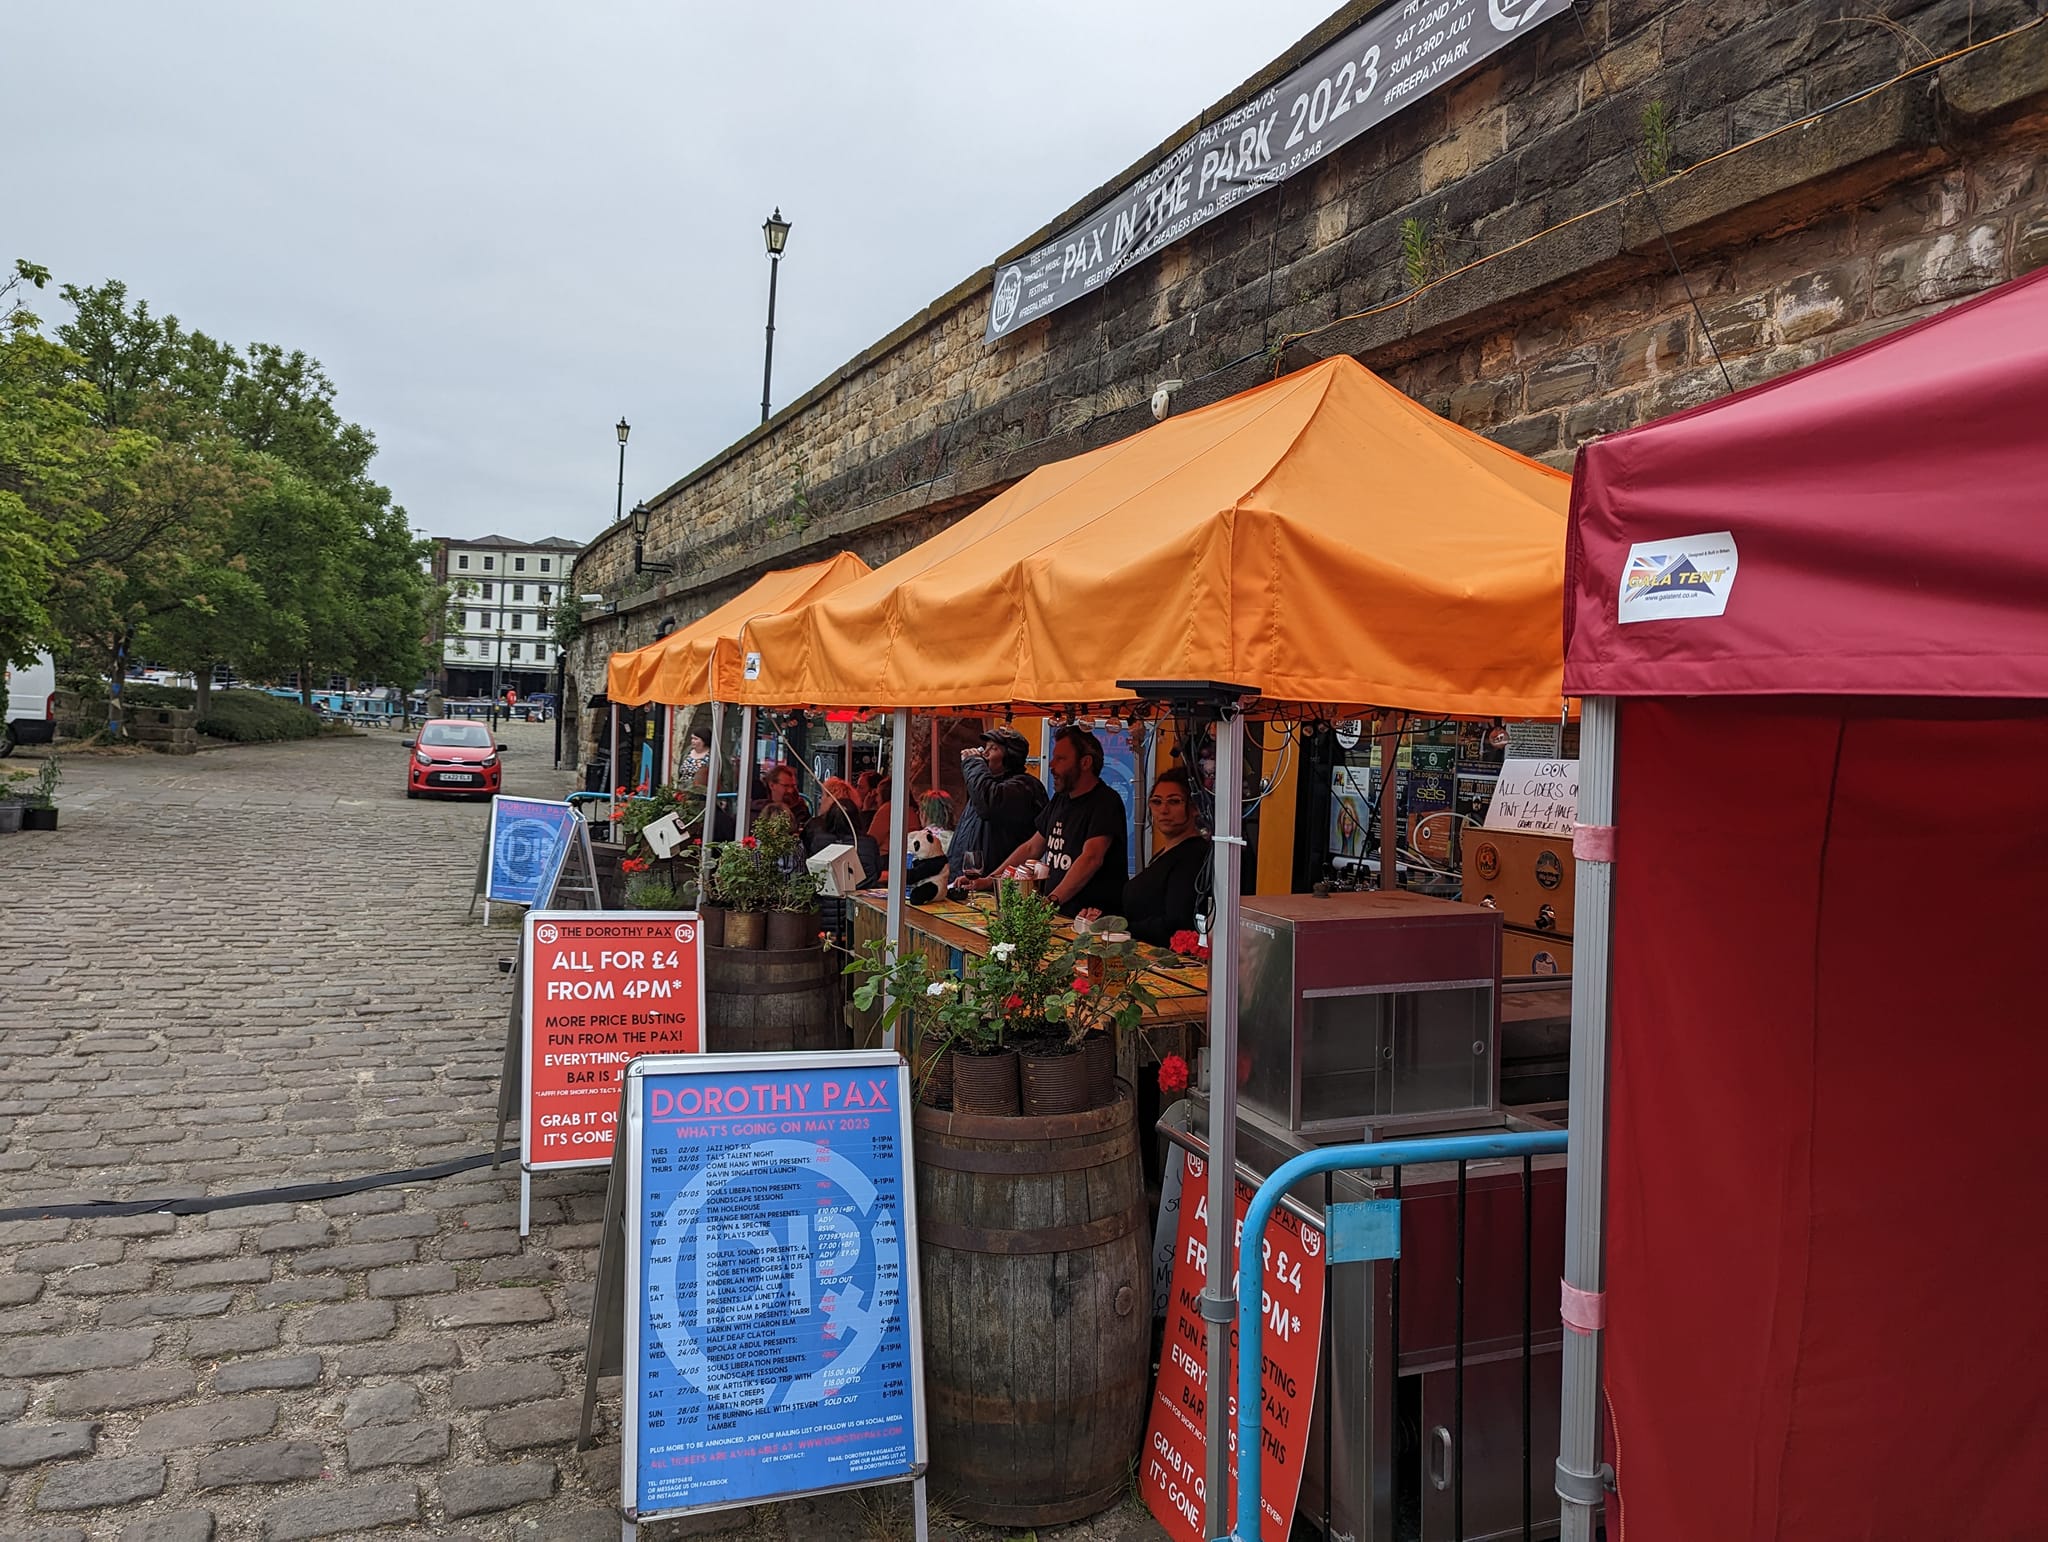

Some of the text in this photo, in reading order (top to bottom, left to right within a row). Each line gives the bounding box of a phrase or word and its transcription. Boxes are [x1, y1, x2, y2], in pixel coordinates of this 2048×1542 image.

[1394, 1, 1449, 50] SAT 22ND
[1390, 8, 1475, 77] SUN 23RD JULY
[1384, 37, 1471, 105] #FREEPAXPARK
[1133, 176, 1151, 197] THE
[1198, 123, 1220, 150] PAX
[1221, 88, 1279, 136] PRESENTS:
[1061, 44, 1381, 285] PAX IN THE PARK 2023
[1153, 215, 1191, 248] GLEADLESS
[1289, 152, 1301, 170] S2
[1628, 569, 1725, 588] GALA TENT
[1645, 592, 1698, 601] www.galatent.co.uk
[1534, 763, 1570, 778] LOOK
[1499, 780, 1520, 796] ALL
[1523, 780, 1564, 800] CIDERS
[1500, 801, 1520, 817] PINT
[1554, 804, 1574, 818] HALF
[560, 925, 672, 938] THE DOROTHY PAX
[551, 950, 680, 971] ALL FOR £4
[547, 980, 616, 1001] FROM
[545, 1012, 686, 1028] MORE PRICE BUSTING
[548, 1030, 683, 1046] FUN FROM THE PAX!
[544, 1051, 631, 1067] EVERYTHING
[567, 1070, 595, 1083] BAR
[599, 1070, 610, 1082] IS
[651, 1080, 888, 1117] DOROTHY PAX
[540, 1113, 581, 1128] GRAB
[584, 1112, 598, 1125] IT
[676, 1117, 870, 1139] WHAT'S GOING ON MAY 2023
[543, 1131, 568, 1147] IT'S
[651, 1144, 723, 1155] TUES JAZZ
[651, 1150, 774, 1164] WED TAL'S TALENT NIGHT
[651, 1156, 812, 1173] THURS COME HANG PRESENTS:
[706, 1166, 797, 1179] GAVIN SINGLETON LAUNCH
[706, 1179, 727, 1188] NIGHT
[706, 1182, 802, 1196] SOULS LIBERATION PRESENTS:
[706, 1193, 784, 1205] SOUNDSCAPE SESSIONS
[706, 1203, 760, 1214] TIM HOLEHOUSE
[651, 1209, 801, 1228] TUES STRANGE BRITAIN PRESENTS:
[706, 1220, 771, 1232] CROWN SPECTRE
[1275, 1205, 1298, 1232] PAX
[651, 1229, 770, 1247] WED PAX PLAYS POKER
[651, 1245, 800, 1265] THURS SOULFUL SOUNDS PRESENTS:
[706, 1257, 760, 1270] CHARITY NIGHT
[706, 1263, 783, 1278] CHLOE BETH RODGERS
[1277, 1251, 1301, 1295] £4
[706, 1276, 746, 1287] KINDERLAN
[738, 1283, 764, 1293] SOCIAL
[706, 1291, 786, 1306] PRESENTS: LUNETTA
[706, 1299, 787, 1315] BRADEN PILLOW
[754, 1308, 789, 1319] PRESENTS:
[1261, 1289, 1301, 1343] PM
[650, 1318, 783, 1334] THURS LARKIN CIARON
[1179, 1316, 1199, 1346] FUN
[706, 1329, 776, 1344] HALF DEAF CLATCH
[650, 1337, 798, 1360] WED BIPOLAR PRESENTS:
[706, 1347, 782, 1363] FRIENDS DOROTHY
[706, 1354, 807, 1373] SOULS LIBERATION PRESENTS:
[706, 1366, 788, 1383] SOUNDSCAPE SESSIONS
[1261, 1354, 1296, 1399] STING
[723, 1378, 759, 1391] ARTISTIK'S
[739, 1387, 765, 1398] CREEPS
[706, 1396, 842, 1412] MARTYN ROPER SOLD
[1182, 1385, 1204, 1420] BAR
[649, 1400, 818, 1429] WED BURNING STEVEN
[706, 1421, 737, 1433] LAMBKE
[649, 1421, 846, 1455] PLUS ANNOUNCED. MAILING FOLLOW
[1261, 1426, 1287, 1465] THIS
[1153, 1431, 1182, 1472] GRAB
[1182, 1461, 1195, 1484] IT
[1149, 1458, 1168, 1490] IT'S
[1168, 1482, 1200, 1533] GONE,
